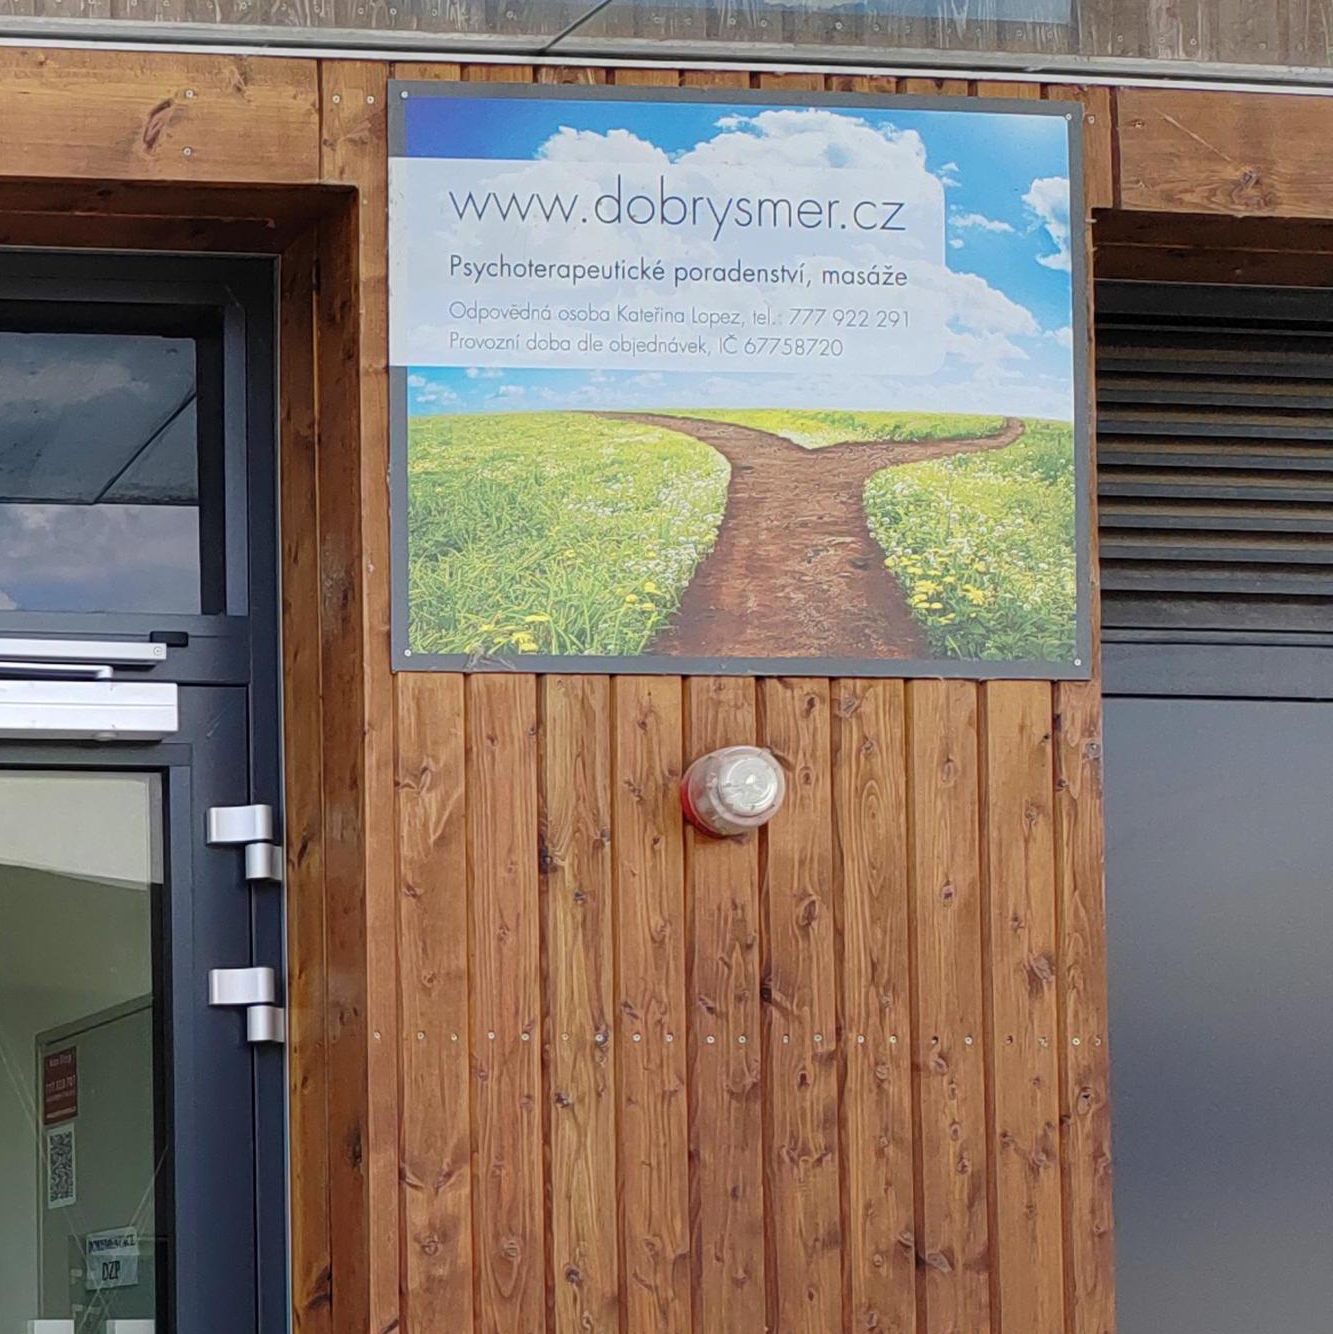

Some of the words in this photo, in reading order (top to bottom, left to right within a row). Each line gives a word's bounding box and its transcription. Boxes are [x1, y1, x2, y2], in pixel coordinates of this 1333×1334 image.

[448, 174, 907, 241] www.dobrysmer.cz
[449, 253, 665, 286] Psychoterapeutické
[674, 259, 812, 288] poradenství,
[822, 265, 908, 287] masáže
[448, 300, 551, 322] Odpovědná
[558, 303, 610, 322] osoba
[616, 304, 685, 324] Kateřina
[691, 306, 746, 328] Lopez,
[788, 308, 826, 326] 777
[833, 308, 870, 328] 922
[876, 310, 910, 328] 291
[449, 331, 521, 351] Provozní
[525, 331, 571, 351] doba
[577, 332, 604, 352] dle
[609, 334, 712, 357] objednávek,
[744, 337, 844, 357] 67758720
